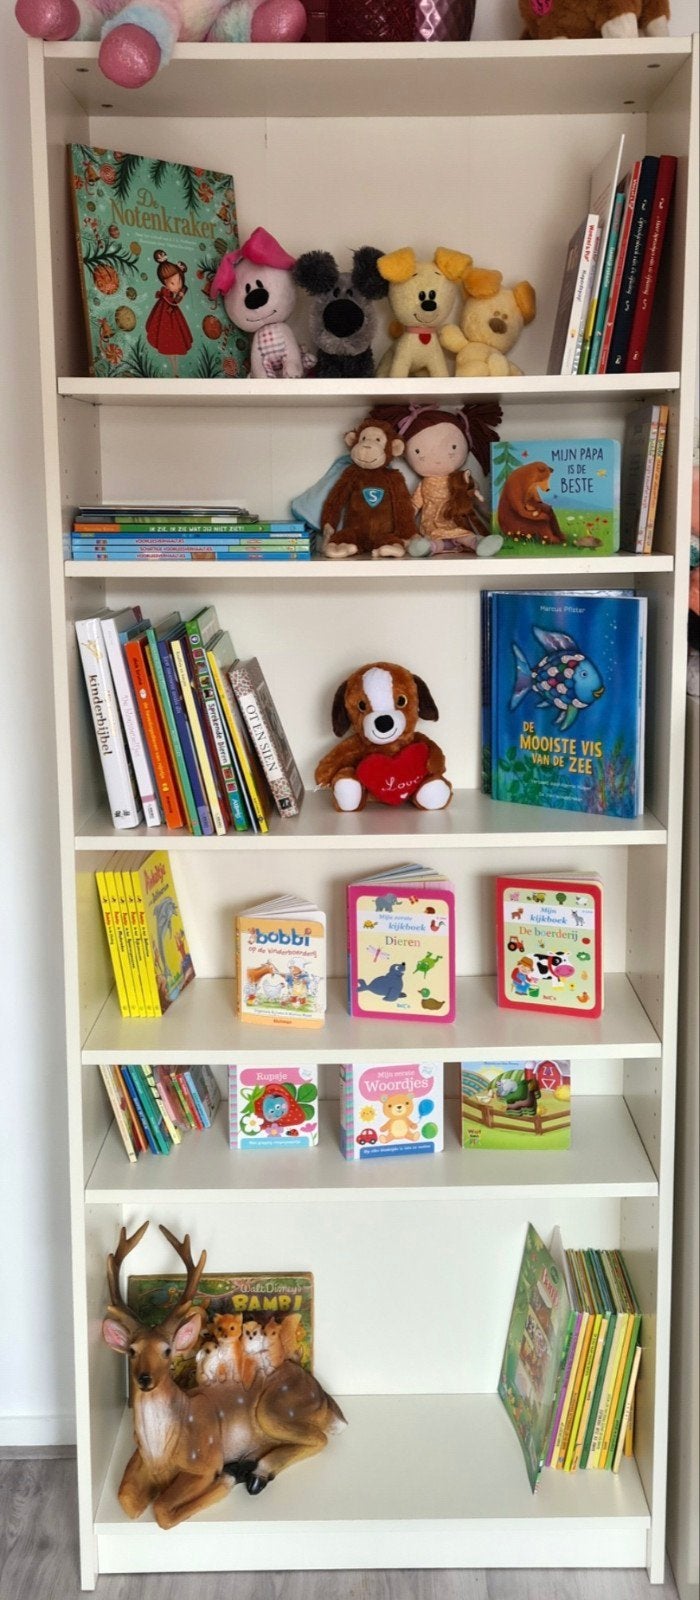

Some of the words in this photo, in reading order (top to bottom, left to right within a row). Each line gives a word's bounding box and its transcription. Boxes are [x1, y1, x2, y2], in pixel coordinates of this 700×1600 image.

[137, 188, 159, 209] De
[109, 198, 217, 239] Notenkraker
[551, 448, 577, 461] MIJN
[580, 447, 604, 461] PAPA
[567, 464, 575, 474] IS
[576, 464, 586, 474] DE
[561, 478, 594, 493] BESTE
[369, 489, 378, 502] S
[564, 606, 587, 614] Pfister
[88, 674, 113, 757] kinderbijbel
[208, 703, 222, 739] Sprekende
[217, 741, 228, 763] Dieren
[523, 721, 534, 733] DE
[246, 704, 259, 722] OT
[254, 722, 266, 740] EN
[260, 741, 278, 772] SIEN
[520, 734, 577, 755] MOOISTE
[581, 740, 603, 758] VIS
[532, 753, 550, 766] VAN
[553, 756, 565, 767] DE
[568, 756, 593, 775] ZEE
[540, 907, 557, 915] Mijn
[388, 922, 427, 932] kijkboek
[529, 915, 568, 925] kijkboek
[255, 927, 312, 947] bobbi
[519, 926, 532, 935] De
[534, 928, 578, 941] boerderij
[385, 936, 421, 947] Dieren
[248, 946, 257, 954] op
[268, 948, 318, 958] kinderboerderij
[256, 1071, 288, 1082] Rupsje
[377, 1071, 391, 1079] Mijn
[364, 1077, 429, 1093] Woordjes
[240, 1282, 265, 1293] Walt
[231, 1294, 303, 1311] BAMBI
